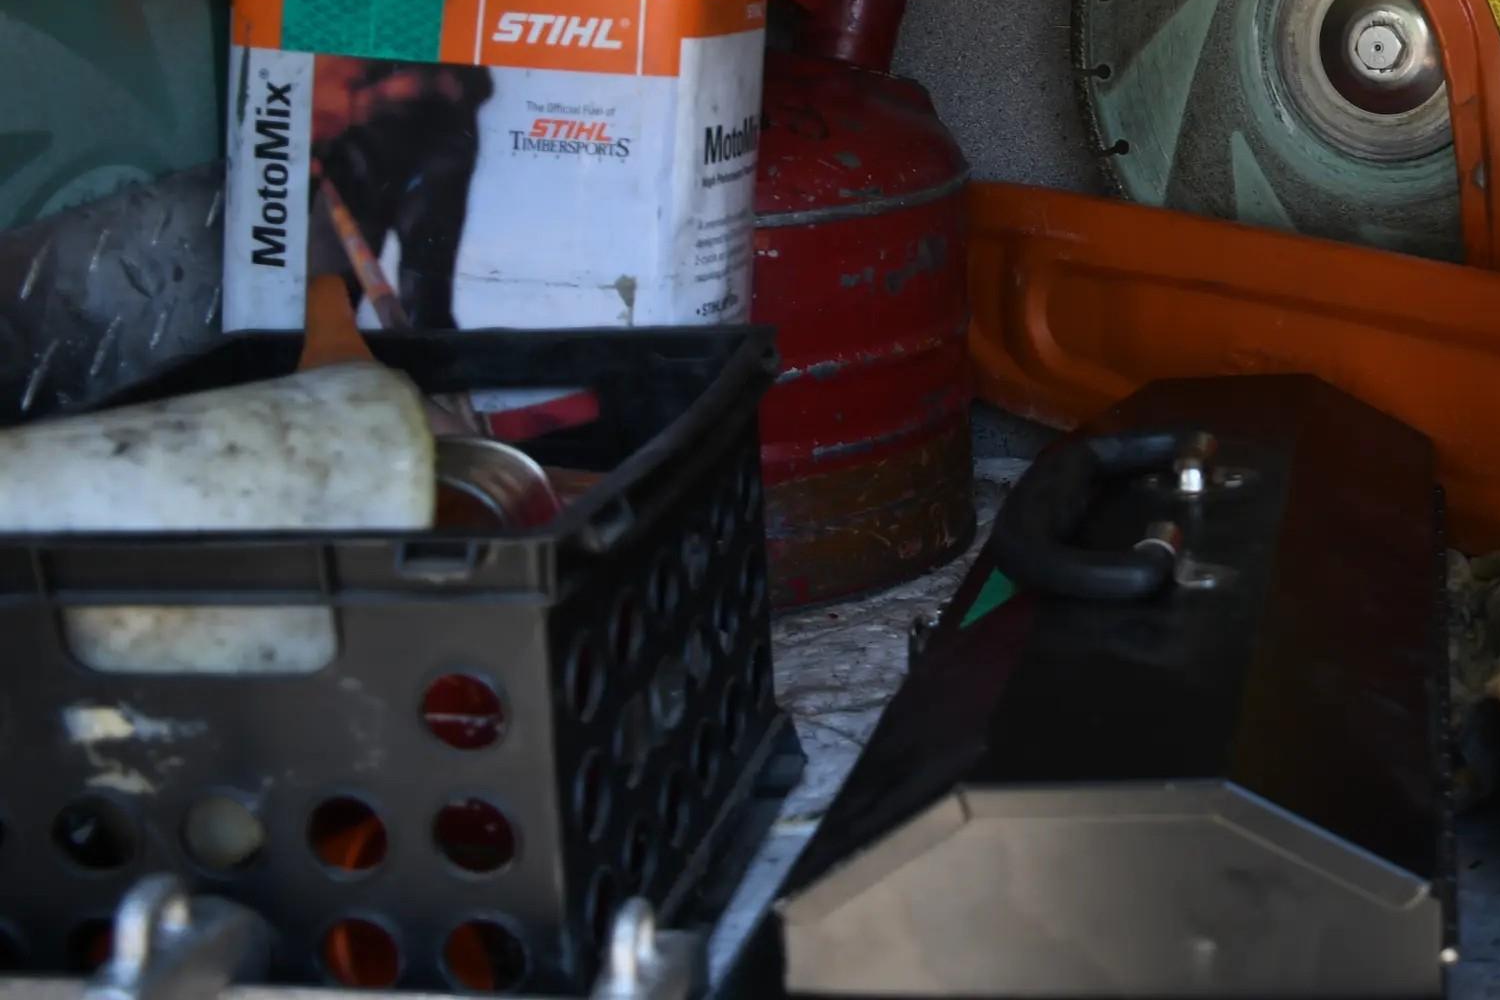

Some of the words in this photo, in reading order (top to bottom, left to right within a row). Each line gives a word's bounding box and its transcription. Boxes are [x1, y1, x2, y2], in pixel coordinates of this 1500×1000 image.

[492, 12, 622, 49] STIHL
[529, 118, 613, 143] STIHL
[252, 81, 292, 267] MotoMix
